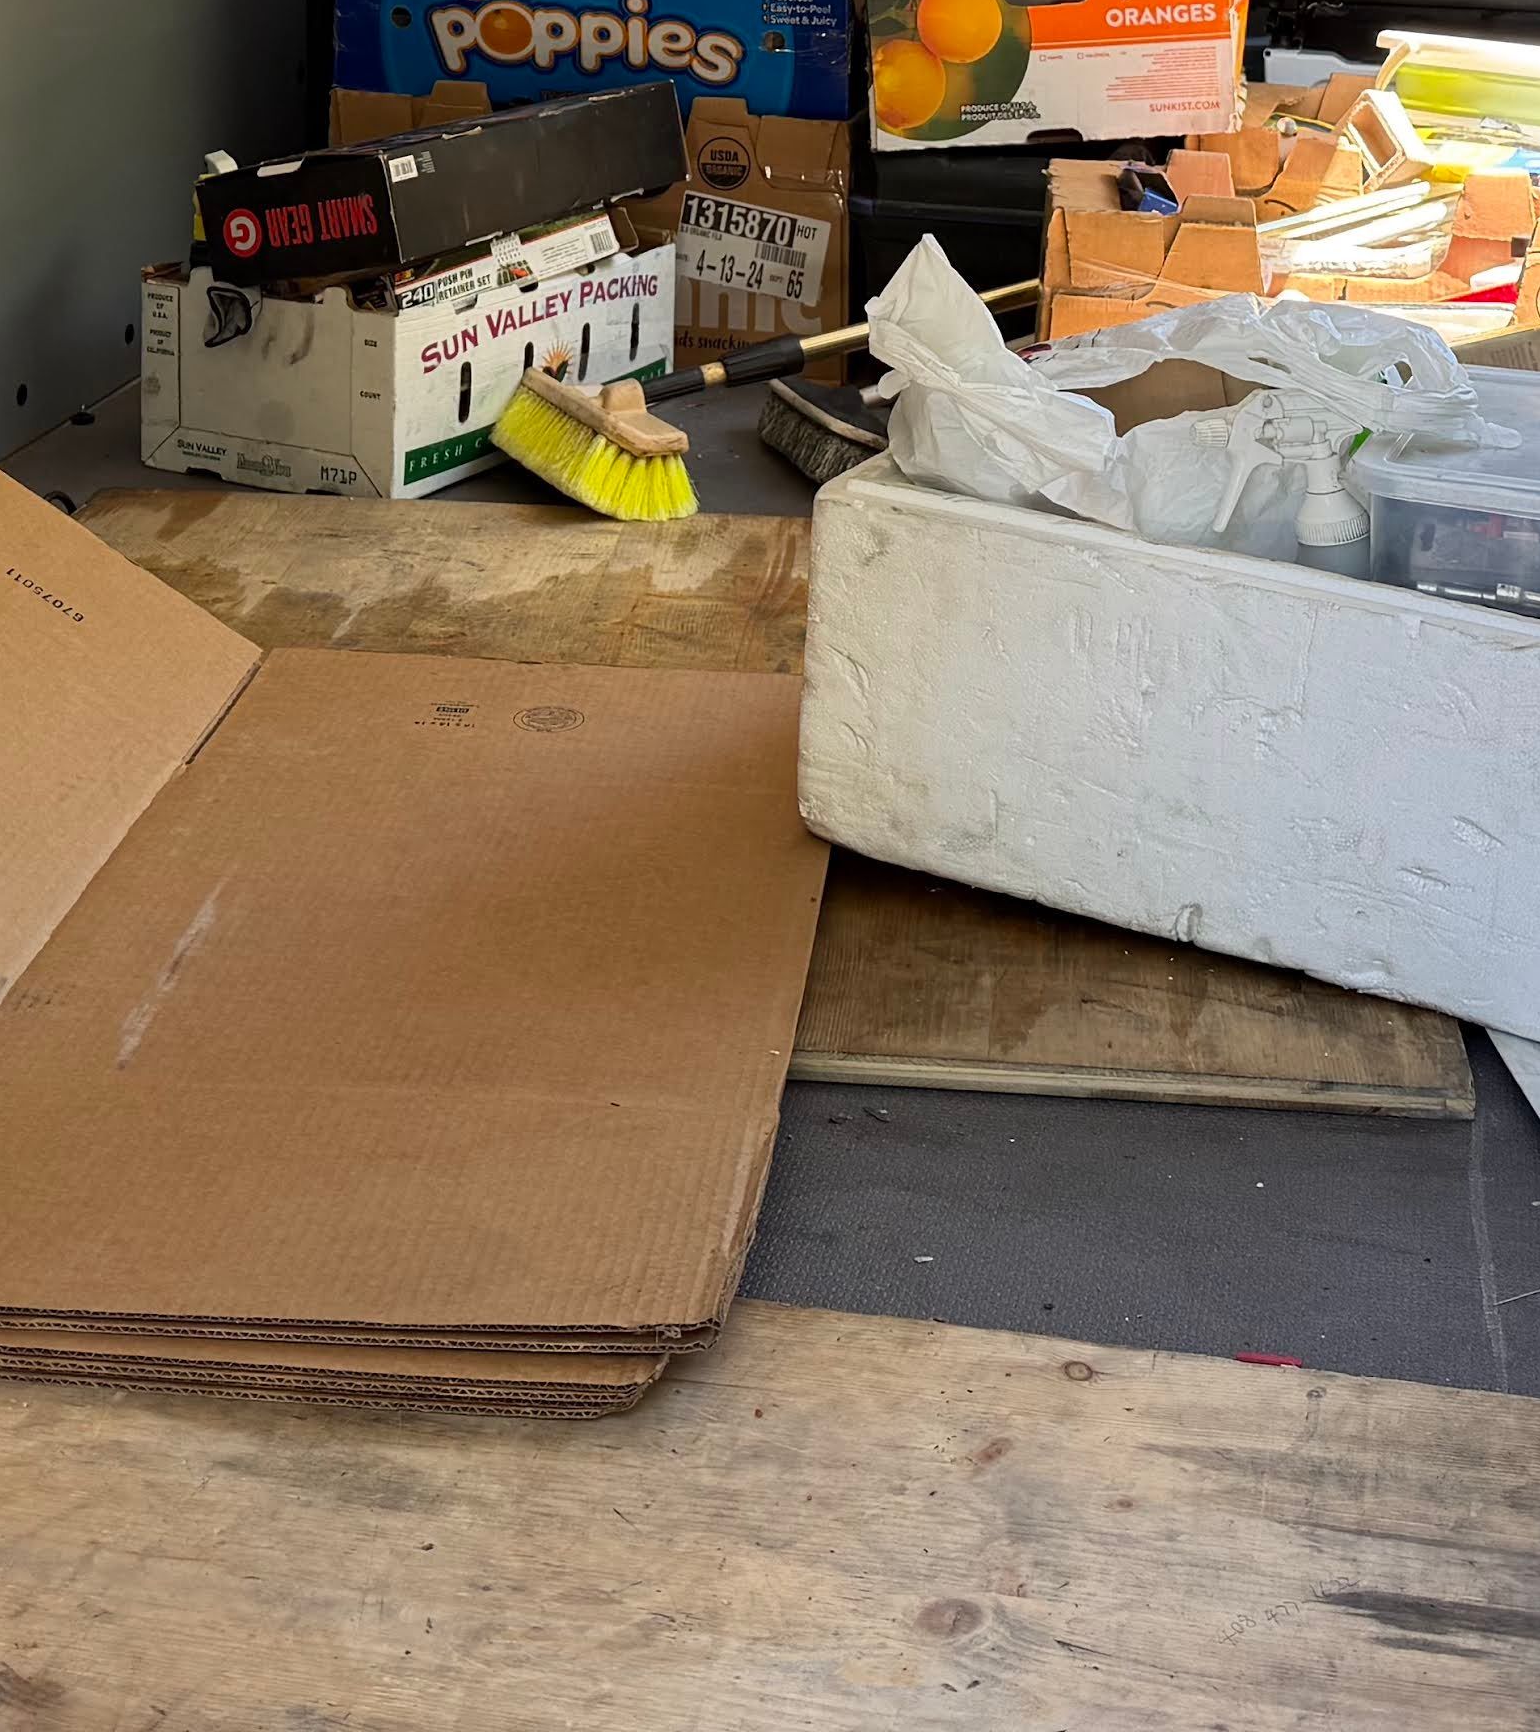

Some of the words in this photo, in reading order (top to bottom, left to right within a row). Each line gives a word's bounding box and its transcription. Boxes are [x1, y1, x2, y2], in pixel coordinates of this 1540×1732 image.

[770, 4, 832, 15] Easy-to-Peel
[770, 15, 800, 25] Sweet
[801, 16, 810, 25] &
[811, 16, 838, 28] Juicy
[1105, 2, 1217, 28] ORANGES
[961, 103, 999, 113] PRODUCE
[1149, 100, 1221, 112] SUNKIST.COM
[710, 149, 739, 162] USDA
[265, 203, 315, 248] GEAR
[318, 193, 378, 242] SMART
[686, 196, 792, 246] 1315870
[796, 224, 818, 242] HOT
[437, 272, 458, 289] PUSH
[459, 268, 473, 281] PIN
[695, 249, 764, 290] 4-13-24
[401, 282, 436, 309] 240
[438, 282, 476, 301] RETAINER
[476, 274, 491, 288] SET
[786, 269, 804, 299] 65
[421, 324, 478, 374] SUN
[485, 289, 573, 339] VALLEY
[579, 274, 658, 309] PACKING
[359, 390, 381, 401] COUNT
[177, 439, 195, 451] SUN
[196, 443, 227, 456] VALLEY
[409, 444, 463, 473] FRESH
[320, 465, 357, 485] M71P
[5, 567, 84, 623] 67075011
